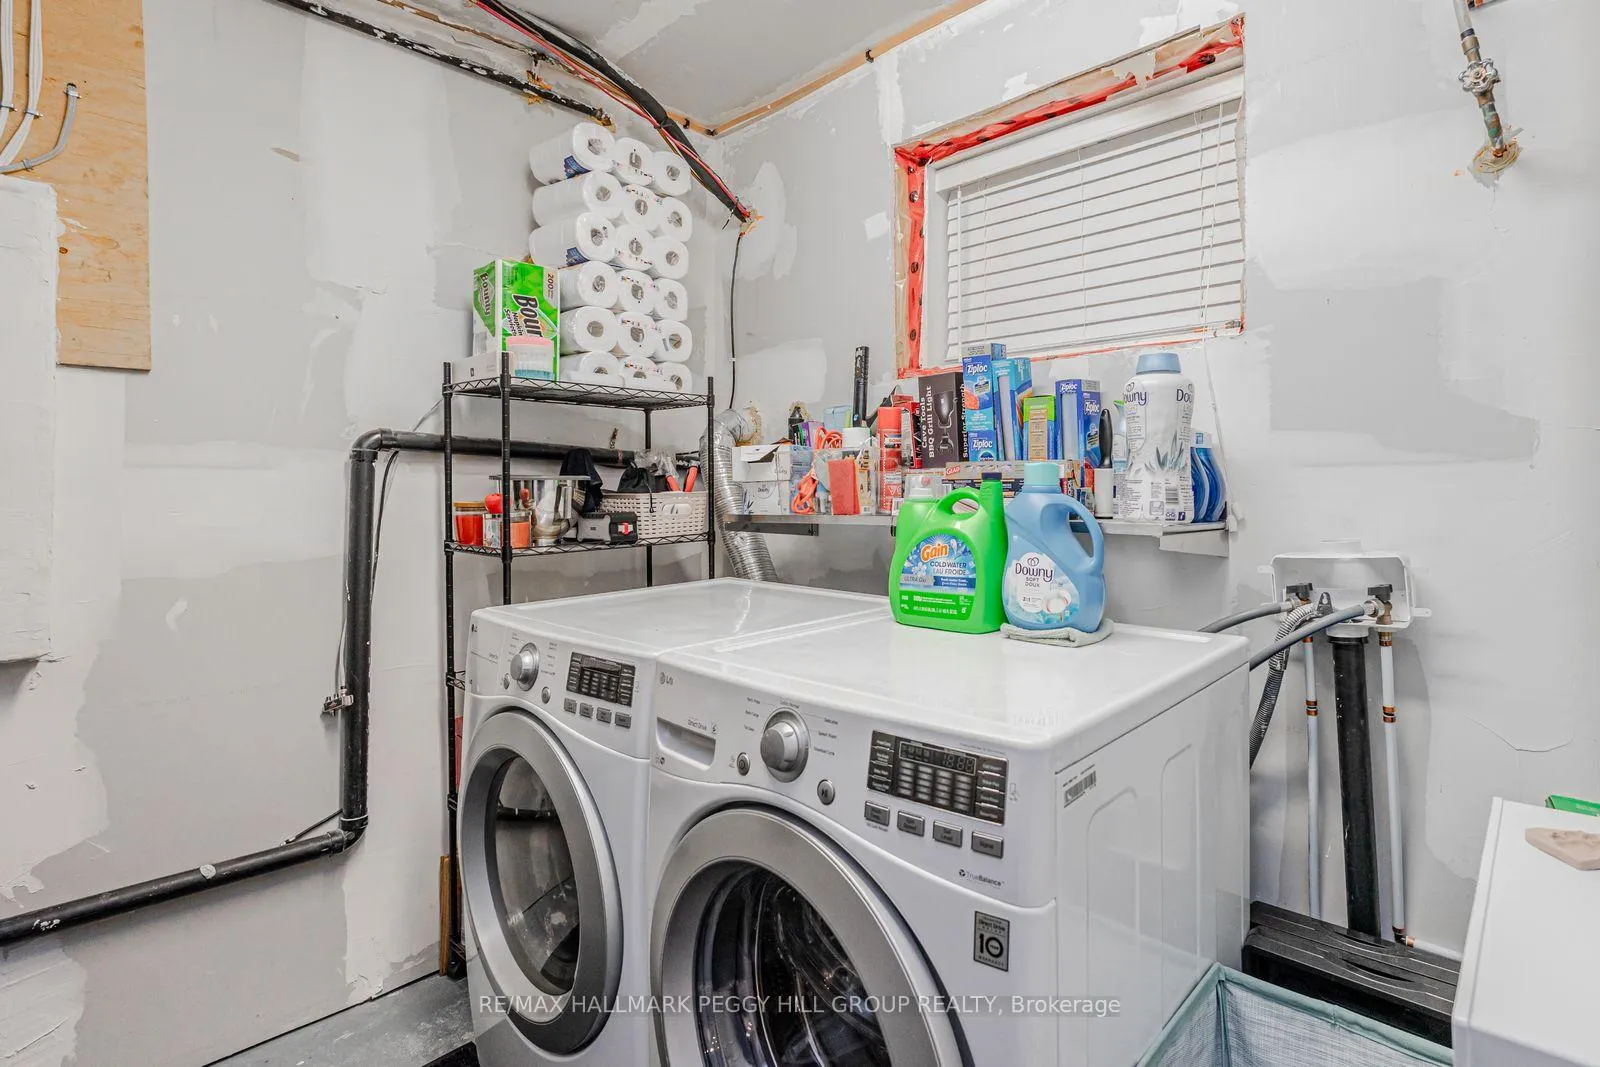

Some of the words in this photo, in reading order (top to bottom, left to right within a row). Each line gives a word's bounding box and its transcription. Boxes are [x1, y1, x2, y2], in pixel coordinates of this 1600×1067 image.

[479, 272, 491, 316] Bounty
[966, 362, 988, 374] Ziploc
[926, 386, 934, 413] Light
[1123, 389, 1147, 405] owny
[972, 440, 993, 452] Ziploc
[921, 542, 948, 562] Gain
[1015, 563, 1053, 582] Downy
[979, 933, 1004, 958] 10
